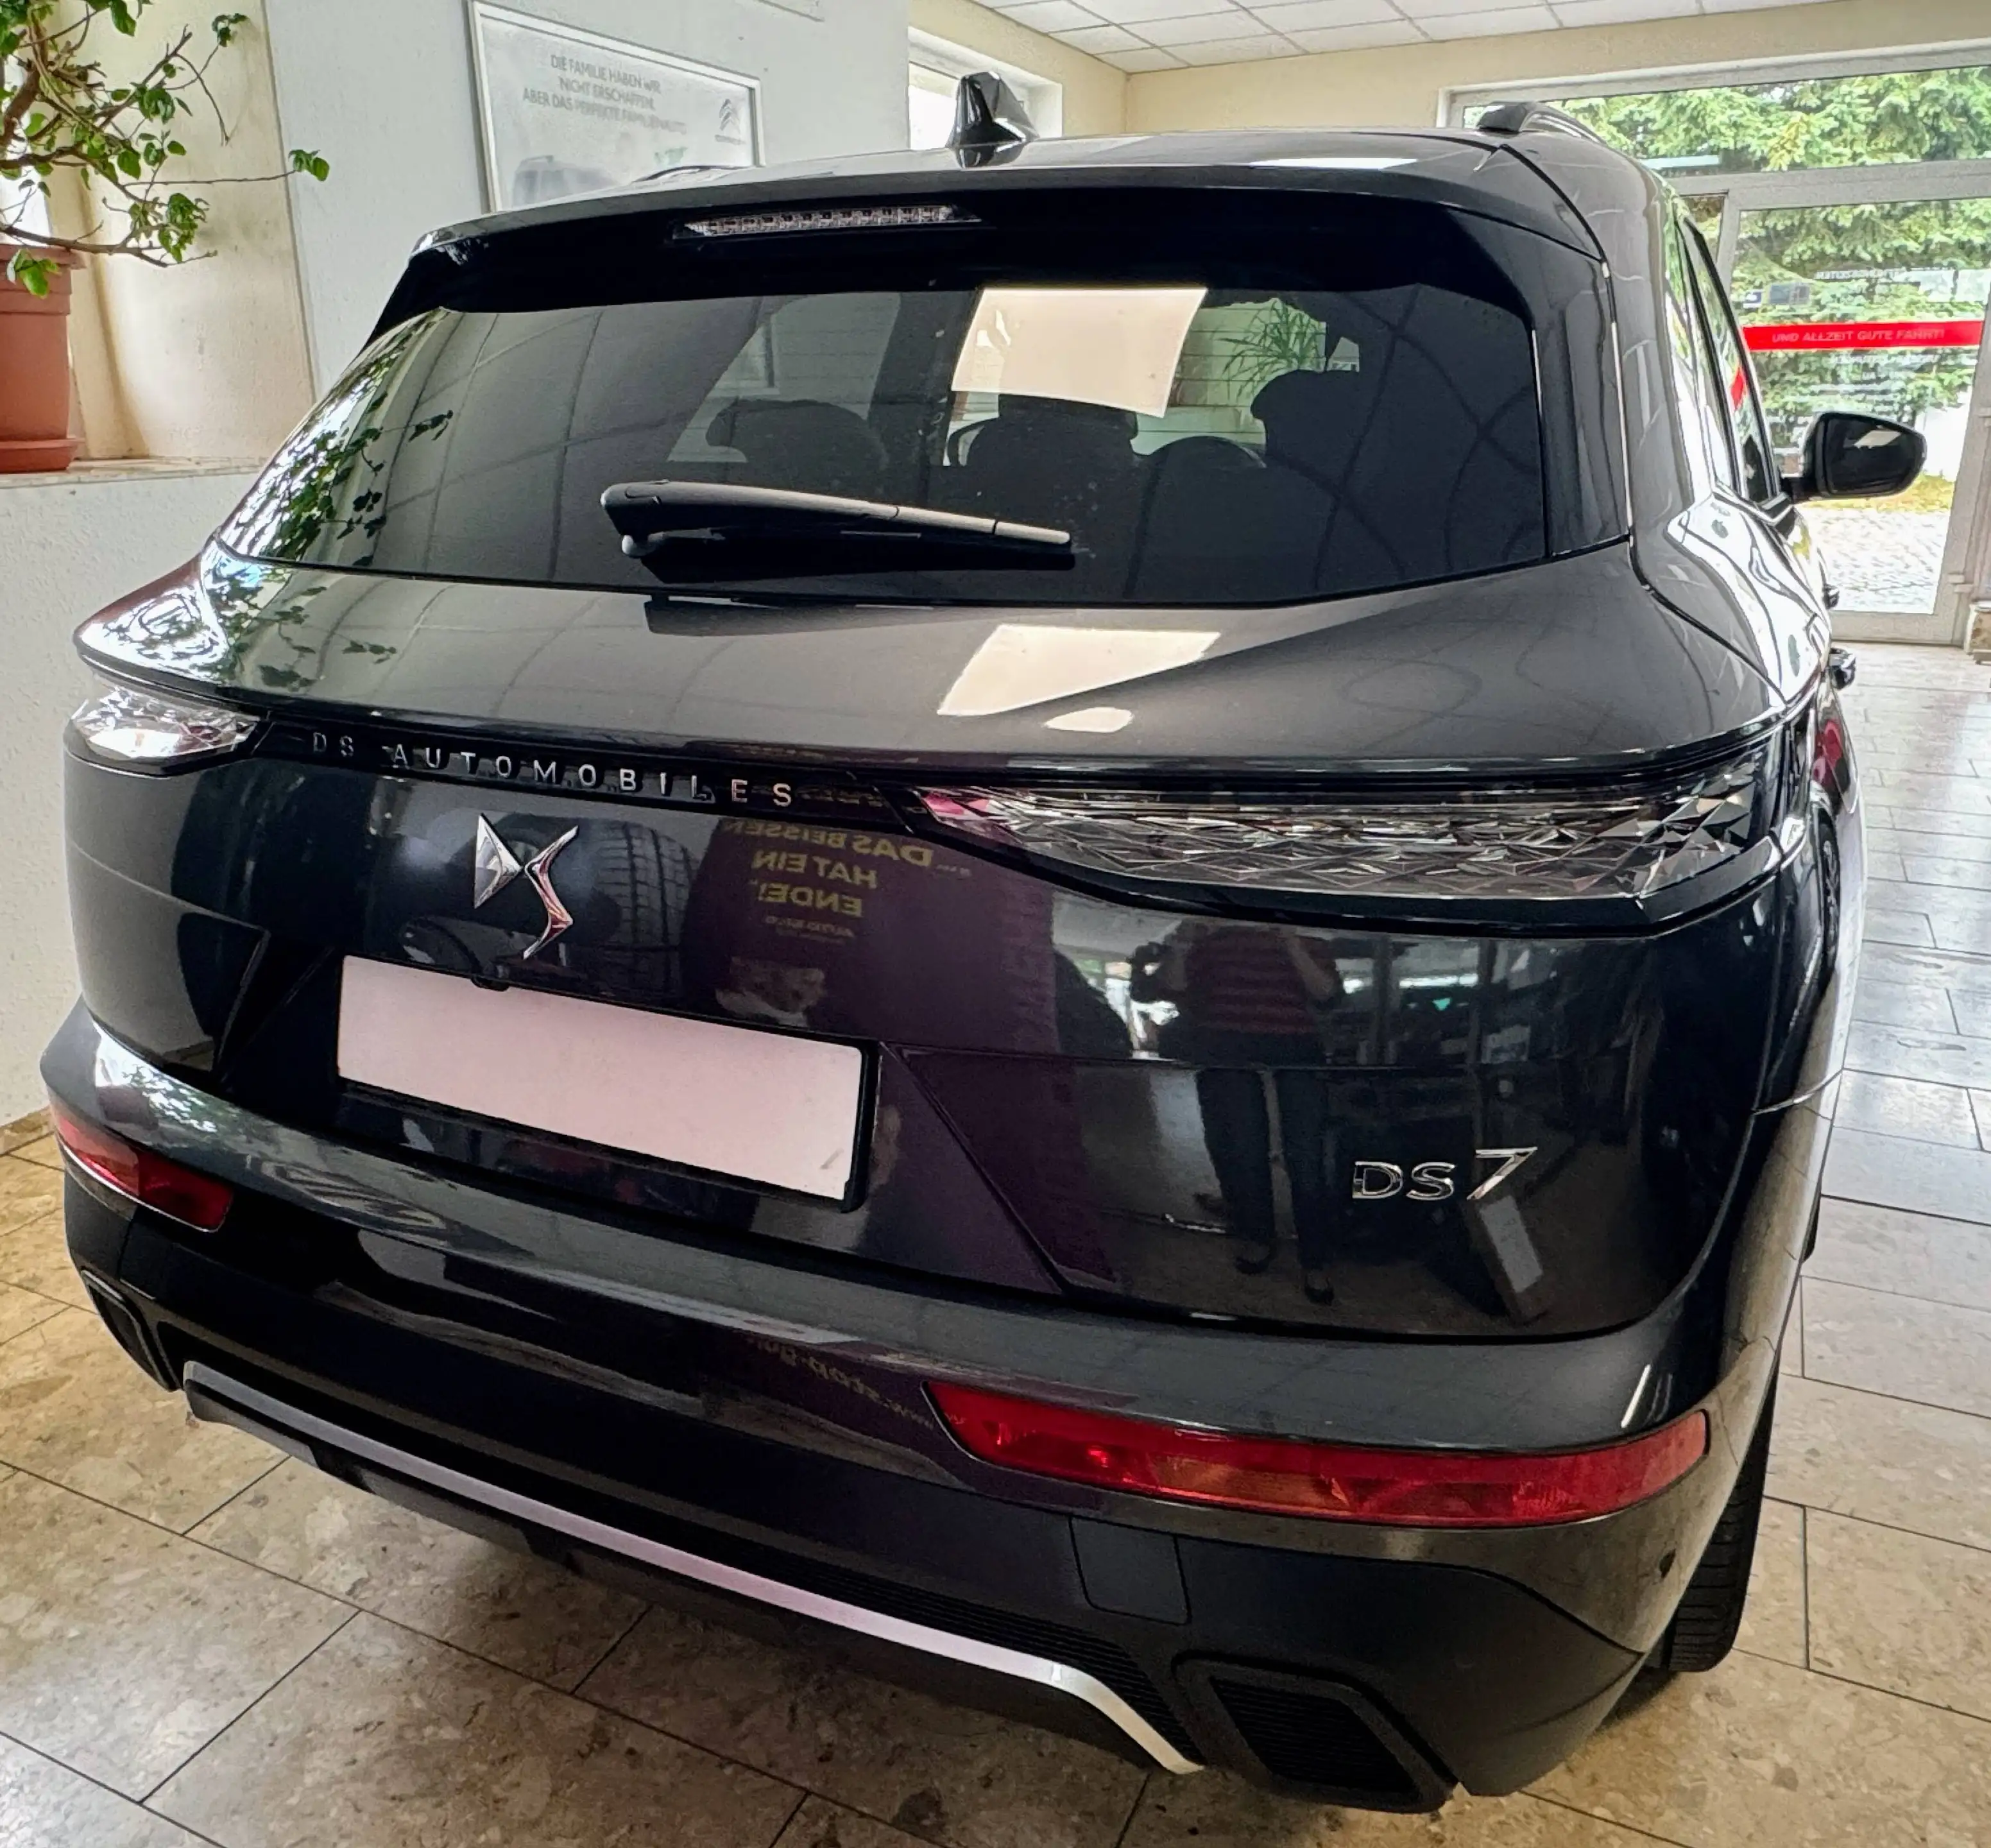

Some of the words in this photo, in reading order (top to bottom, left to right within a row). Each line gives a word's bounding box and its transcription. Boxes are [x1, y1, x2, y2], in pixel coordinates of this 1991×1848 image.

[551, 55, 567, 71] DIE
[558, 75, 590, 96] NICHT
[522, 87, 551, 107] ABER
[551, 92, 574, 111] DAS
[1772, 332, 1799, 343] UND
[1801, 330, 1854, 342] ALLZEIT
[1856, 329, 1893, 341] GUTE
[1895, 328, 1946, 341] FAHRT!
[311, 732, 355, 757] DS
[391, 743, 794, 807] AUTOMOBILES
